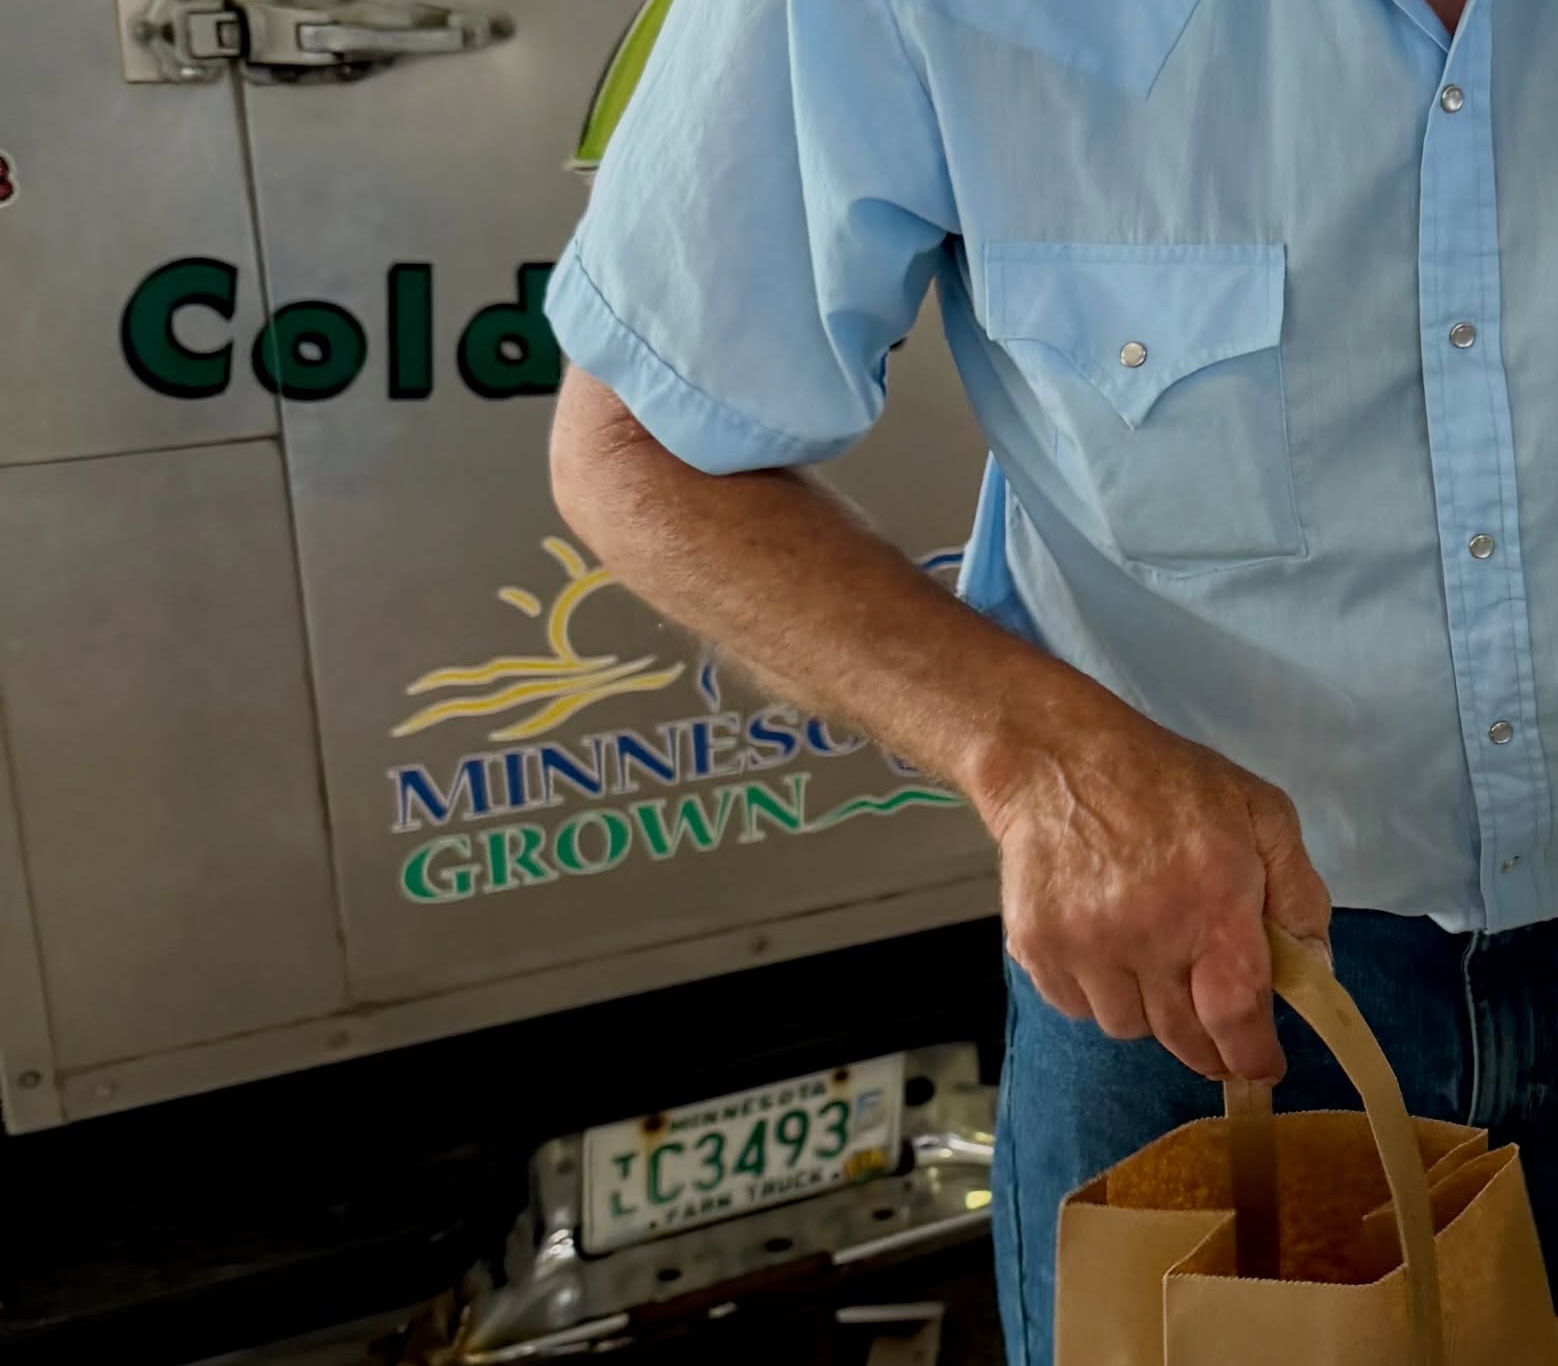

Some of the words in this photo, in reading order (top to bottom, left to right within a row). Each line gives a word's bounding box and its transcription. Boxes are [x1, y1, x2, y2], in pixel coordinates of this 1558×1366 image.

[120, 256, 563, 401] Cold
[389, 705, 922, 833] MINNESO
[401, 773, 812, 905] GROWN
[646, 1099, 851, 1206] C3493
[669, 1081, 829, 1132] MINNESOTA
[666, 1194, 734, 1223] FARM
[748, 1172, 824, 1201] TRUCK
